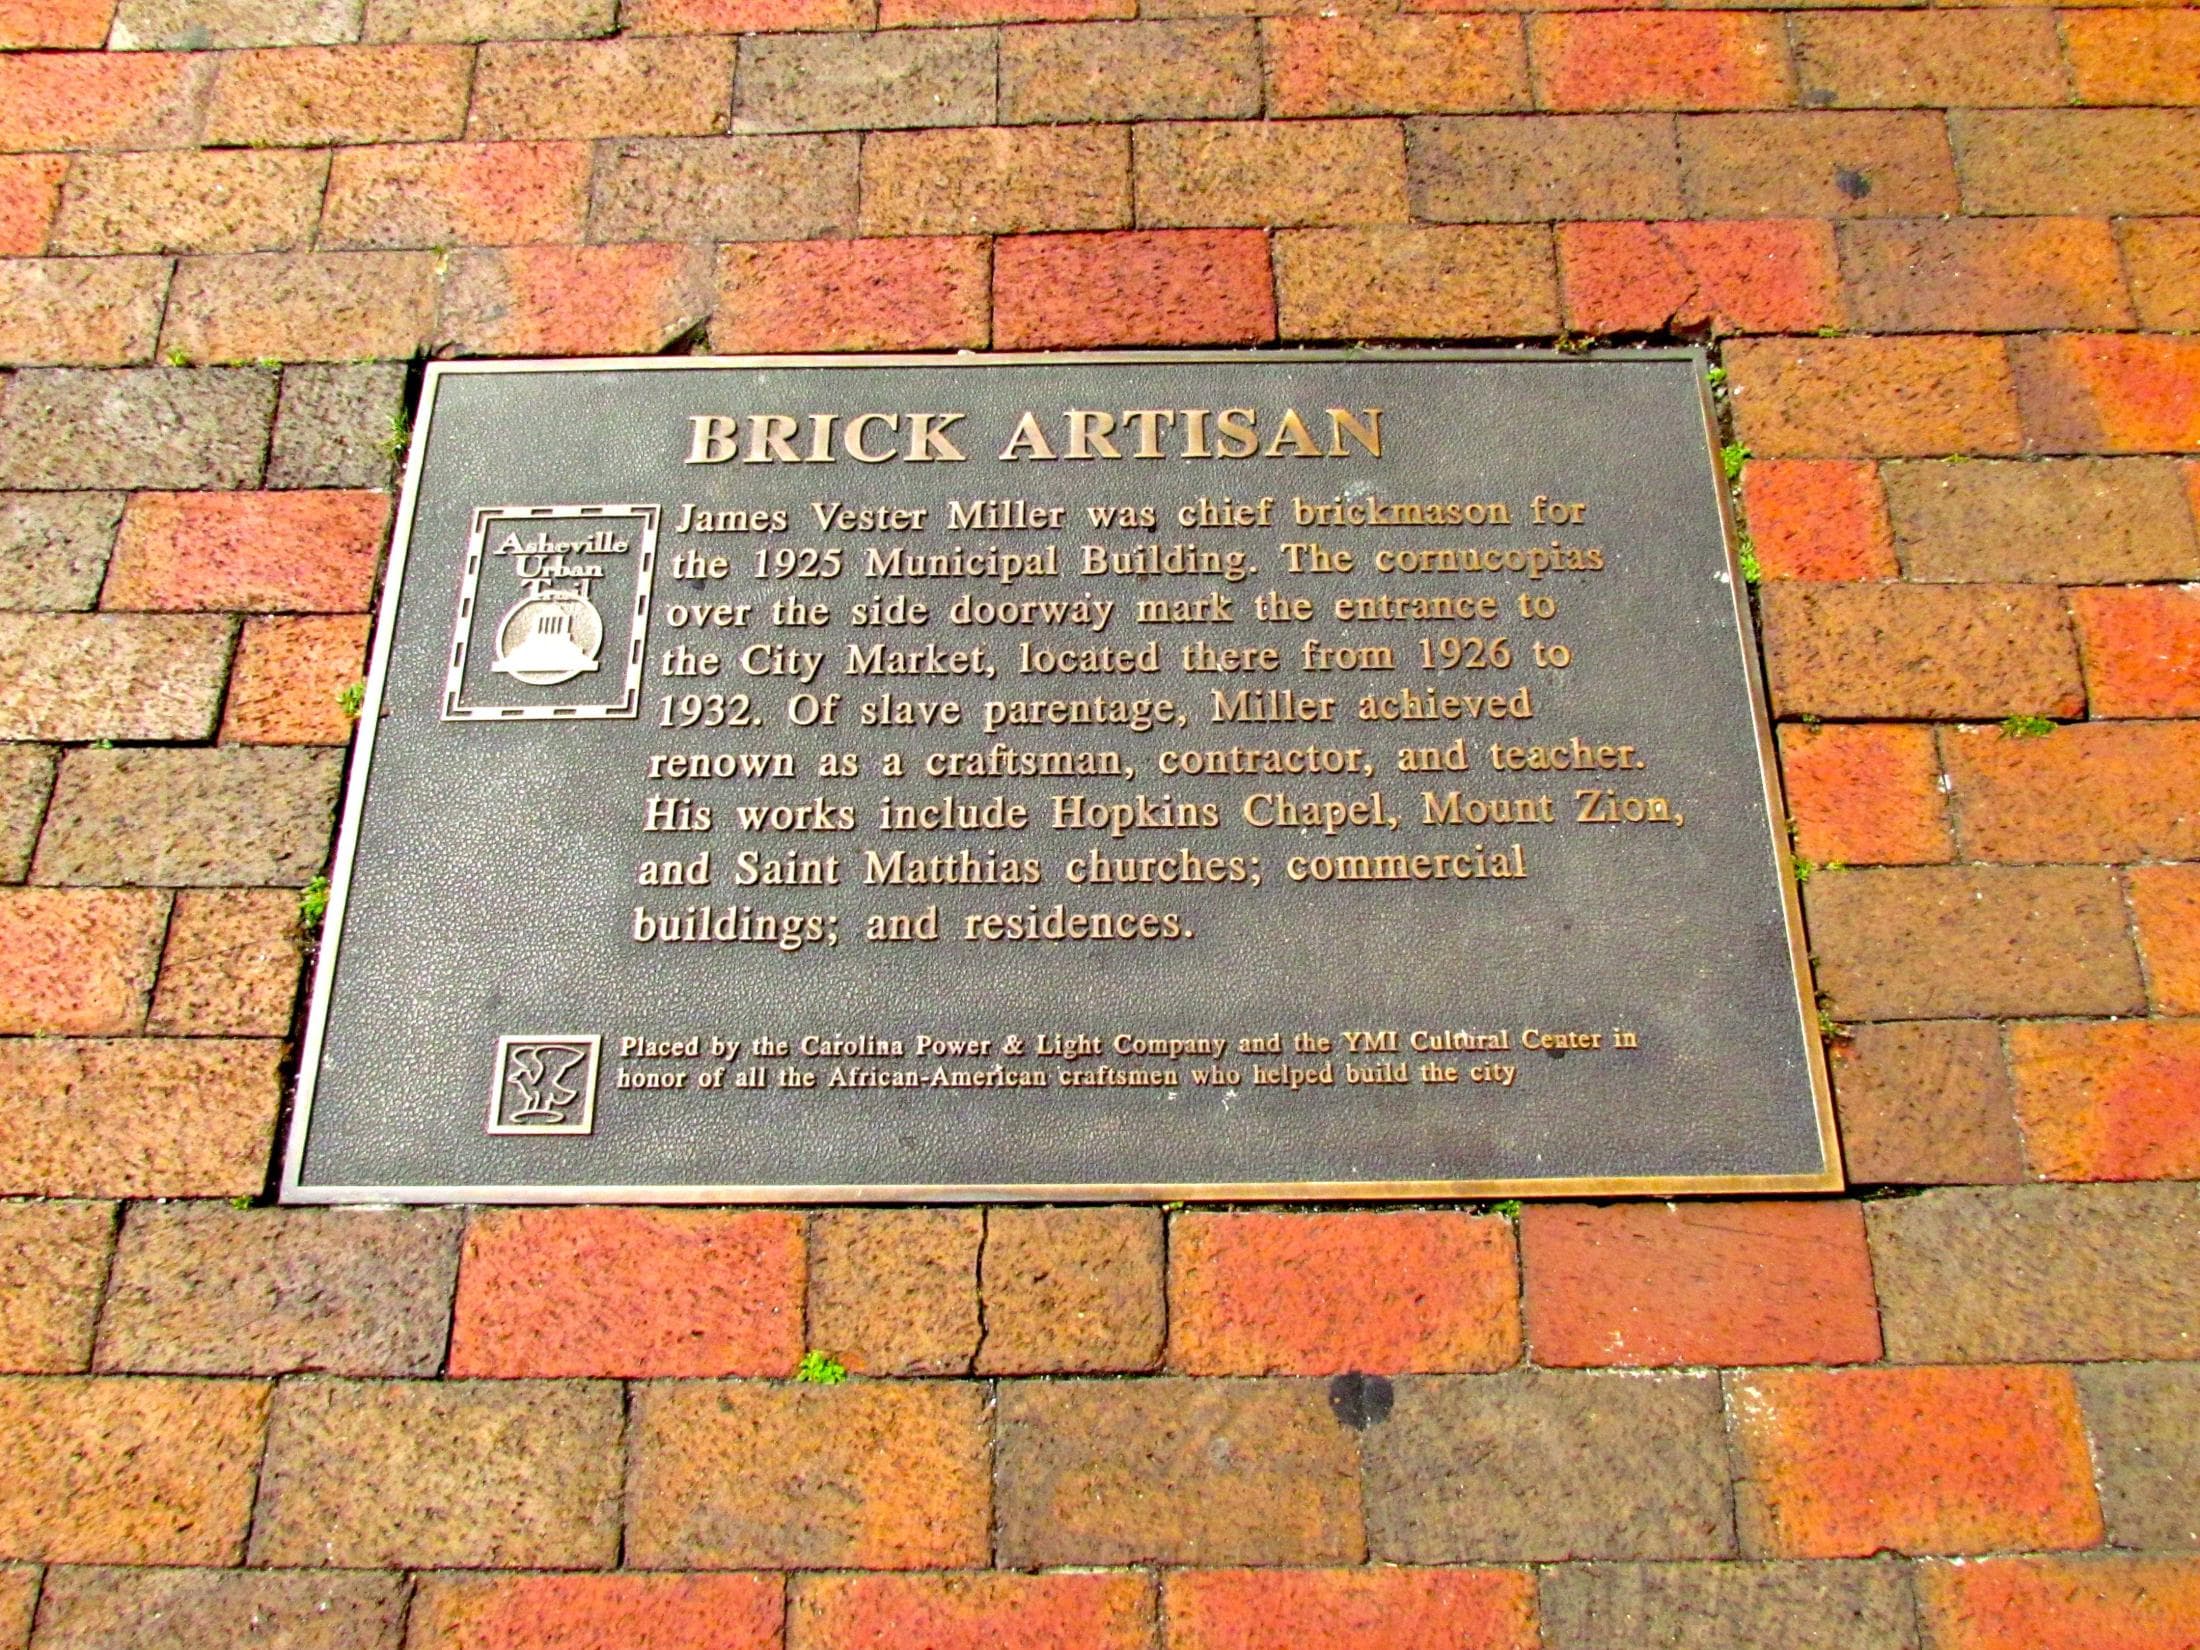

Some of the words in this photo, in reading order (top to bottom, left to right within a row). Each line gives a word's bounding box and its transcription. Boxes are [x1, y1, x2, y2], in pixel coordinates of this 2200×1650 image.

[684, 413, 966, 465] BRICK
[1000, 407, 1384, 461] ARTISAN
[676, 503, 788, 534] James
[811, 502, 927, 531] Vester
[947, 500, 1065, 530] Miller
[1088, 506, 1156, 528] was
[1178, 497, 1273, 527] chief
[1294, 497, 1510, 526] brickmason
[1531, 496, 1586, 524] for
[494, 531, 629, 555] Asheville
[673, 550, 728, 579] the
[754, 549, 841, 578] 1925
[865, 546, 1056, 582] Municipal
[1081, 546, 1256, 582] Building.
[1281, 544, 1353, 573] The
[1376, 543, 1604, 578] cornucopias
[517, 555, 603, 578] Urban
[667, 601, 750, 627] over
[772, 598, 829, 626] the
[852, 597, 927, 625] side
[951, 597, 1113, 630] doorway
[1137, 593, 1233, 623] mark
[1255, 592, 1312, 621] the
[1335, 594, 1497, 620] entrance
[1518, 594, 1556, 619] to
[661, 646, 720, 676] the
[741, 644, 824, 681] City
[846, 644, 995, 678] Market,
[1020, 643, 1159, 672] located
[1182, 641, 1279, 670] there
[1302, 640, 1395, 670] from
[1420, 638, 1510, 668] 1926
[1532, 640, 1572, 667] to
[658, 695, 762, 728] 1932.
[788, 692, 839, 725] Of
[861, 694, 960, 725] slave
[985, 697, 1188, 732] parentage,
[1211, 689, 1335, 721] Miller
[1358, 688, 1533, 719] achieved
[647, 753, 795, 779] renown
[819, 753, 859, 777] as
[883, 753, 903, 776] a
[926, 743, 1134, 780] craftsman,
[1158, 745, 1375, 776] contractor,
[1398, 739, 1468, 772] and
[1490, 738, 1645, 770] teacher.
[643, 796, 712, 832] His
[737, 797, 856, 831] works
[880, 797, 1028, 830] include
[1052, 796, 1219, 837] Hopkins
[1243, 793, 1399, 835] Chapel,
[1421, 791, 1554, 825] Mount
[1575, 790, 1685, 828] Zion,
[639, 853, 710, 886] and
[735, 852, 840, 885] Saint
[863, 851, 1041, 884] Matthias
[1066, 848, 1263, 884] churches;
[1286, 845, 1527, 880] commercial
[634, 907, 839, 950] buildings;
[866, 907, 938, 940] and
[965, 906, 1193, 939] residences.
[619, 1037, 698, 1058] Placed
[710, 1036, 741, 1062] by
[752, 1036, 789, 1058] the
[801, 1034, 903, 1057] Carolina
[915, 1035, 991, 1056] Power
[1004, 1036, 1023, 1056] &
[1037, 1034, 1102, 1060] Light
[1114, 1034, 1226, 1060] Company
[1239, 1032, 1281, 1054] and
[1295, 1032, 1331, 1053] the
[1343, 1031, 1398, 1052] YMI
[1410, 1031, 1509, 1051] Cultural
[1521, 1030, 1601, 1050] Center
[1613, 1029, 1637, 1048] in
[617, 1068, 687, 1089] honor
[698, 1067, 726, 1089] of
[736, 1066, 768, 1089] all
[779, 1066, 815, 1089] the
[828, 1066, 1046, 1089] African-American
[1060, 1064, 1178, 1086] craftsmen
[1191, 1063, 1240, 1086] who
[1253, 1064, 1333, 1089] helped
[1346, 1062, 1408, 1084] build
[1422, 1062, 1457, 1083] the
[1470, 1063, 1517, 1088] city
